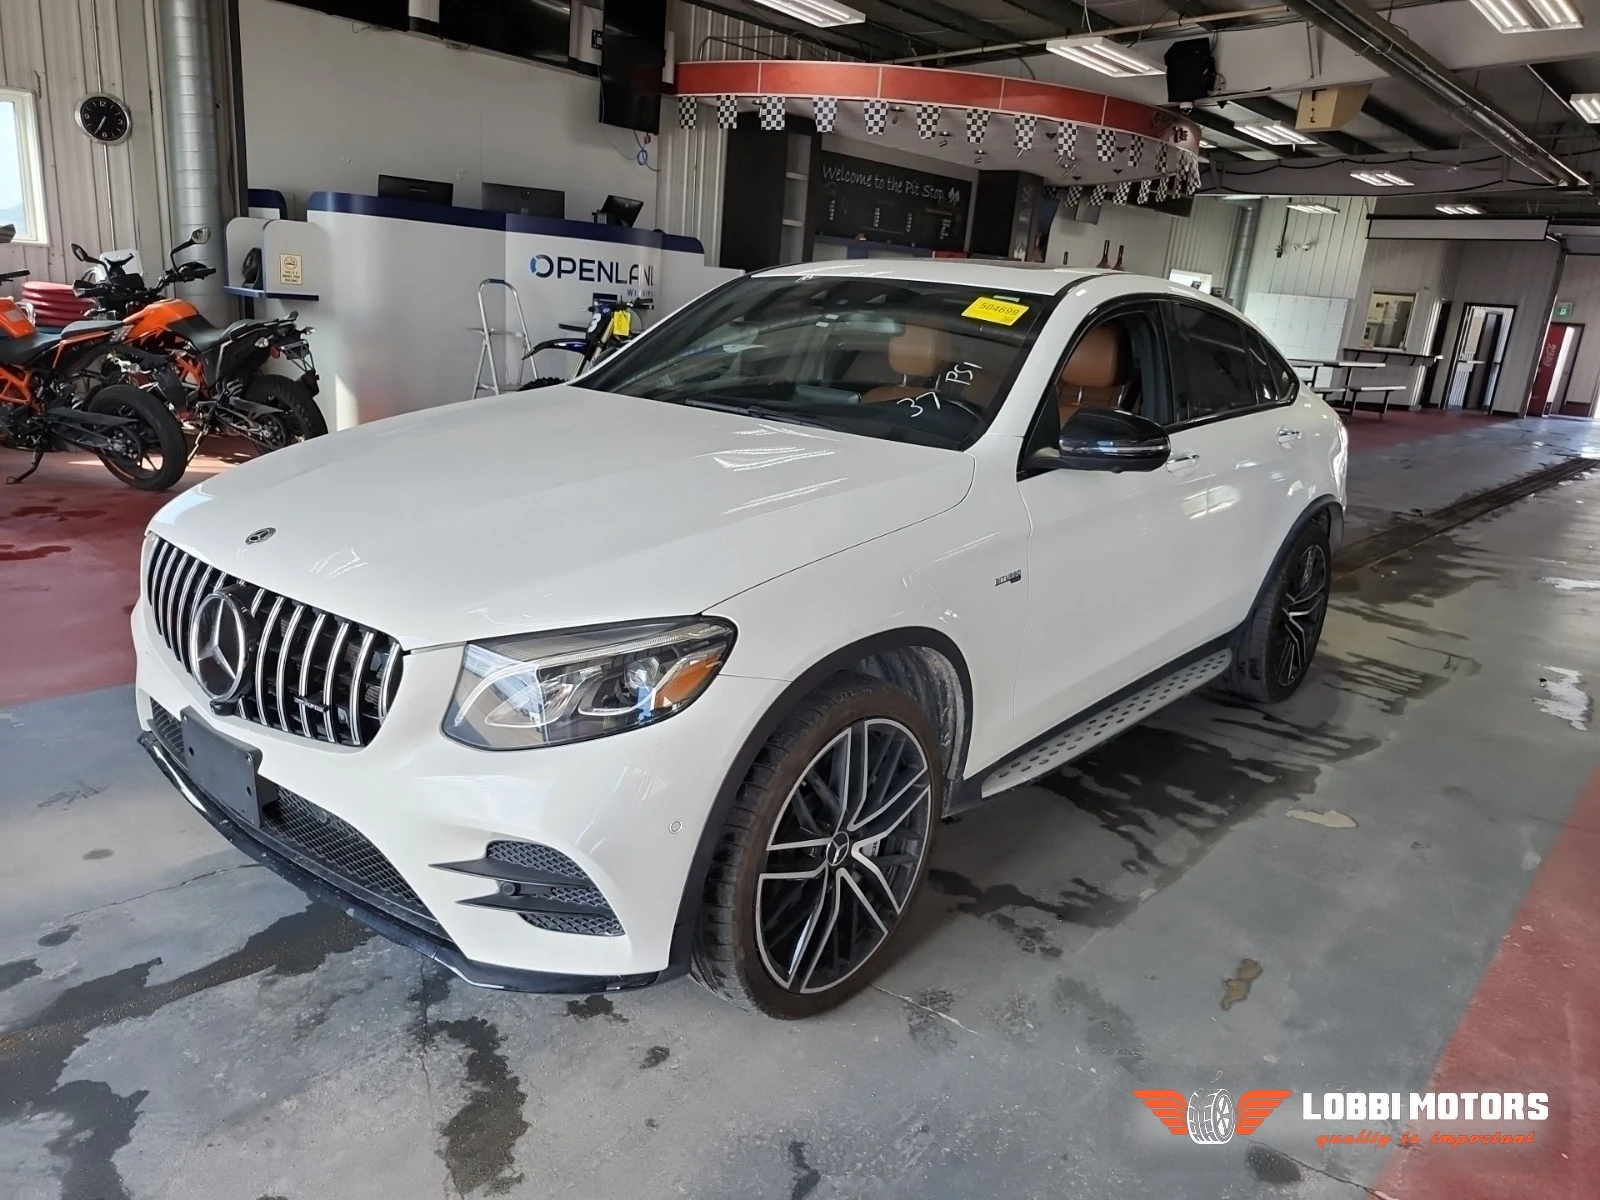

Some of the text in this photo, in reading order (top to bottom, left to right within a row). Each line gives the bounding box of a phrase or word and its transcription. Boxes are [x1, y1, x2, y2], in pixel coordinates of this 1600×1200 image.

[823, 165, 944, 204] Welcome to the Pit Stop
[979, 302, 1020, 316] 504699
[896, 361, 983, 417] 37 PSI
